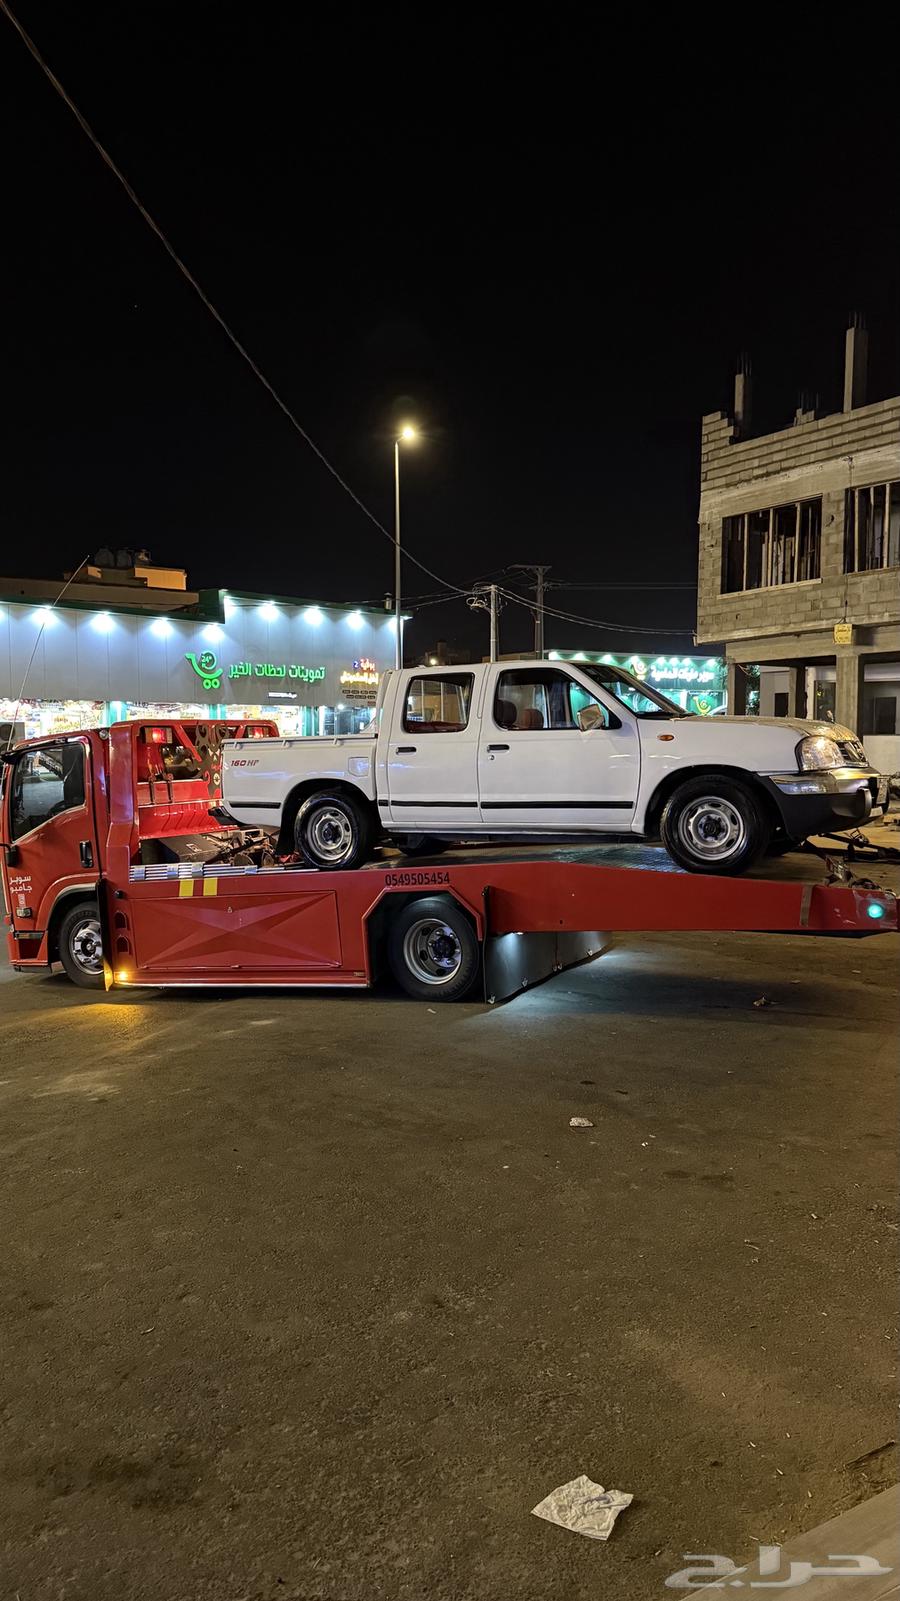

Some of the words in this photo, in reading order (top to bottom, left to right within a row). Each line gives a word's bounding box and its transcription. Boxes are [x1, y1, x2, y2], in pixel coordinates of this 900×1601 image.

[228, 661, 252, 678] الخير
[255, 664, 286, 678] لحظات
[289, 664, 326, 682] تموينات
[9, 875, 32, 885] سوبر
[384, 871, 450, 887] 0549505454
[10, 883, 33, 894] جامبو
